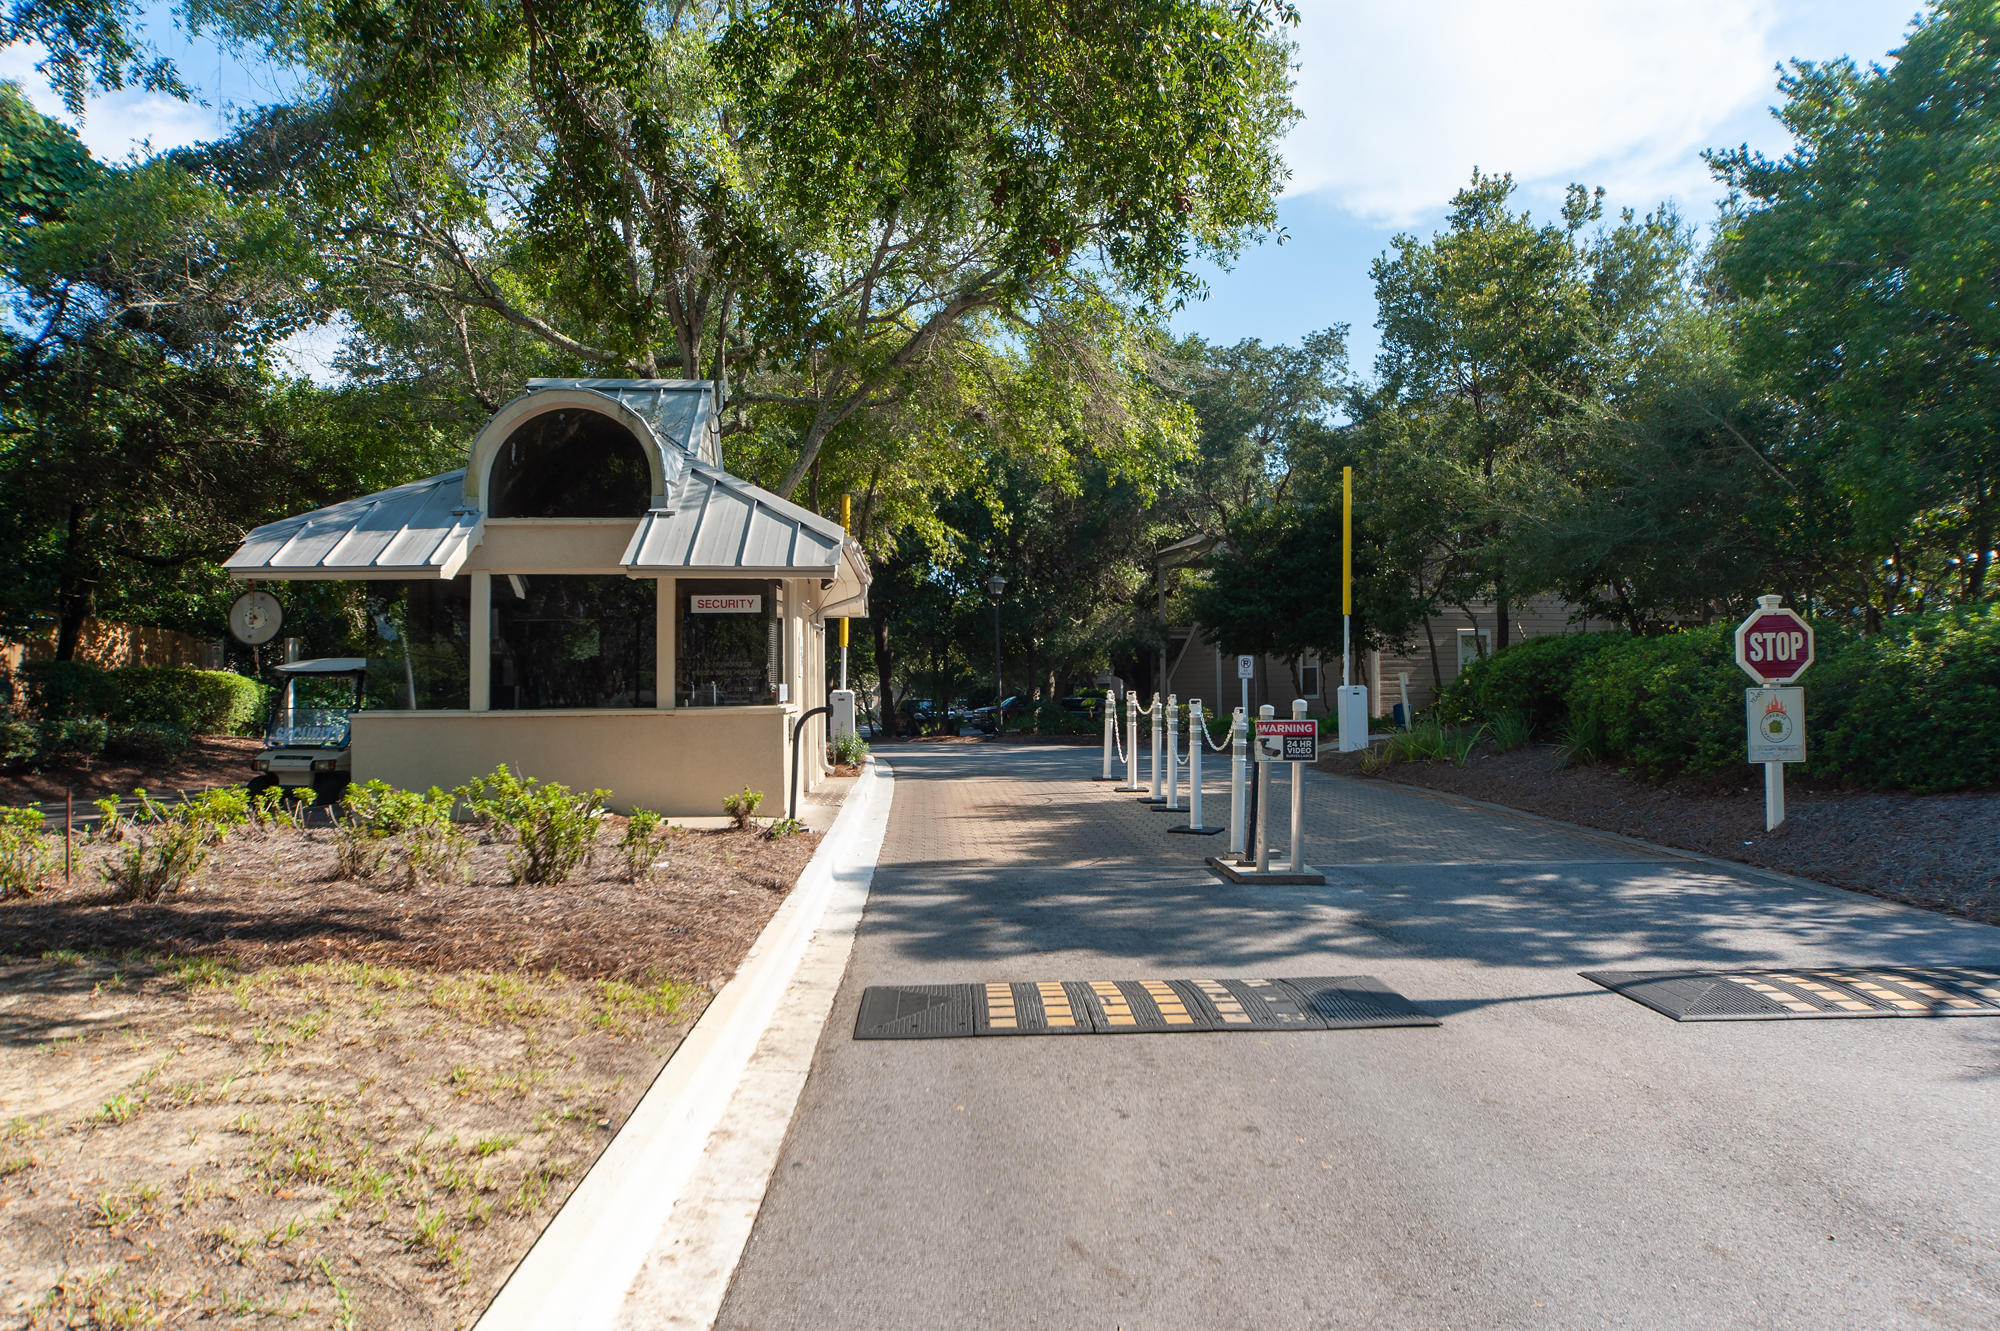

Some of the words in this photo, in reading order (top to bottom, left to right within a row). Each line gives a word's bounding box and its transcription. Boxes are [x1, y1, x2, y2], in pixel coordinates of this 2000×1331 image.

[697, 599, 754, 609] SECURITY
[1749, 632, 1804, 662] STOP
[276, 727, 341, 742] SECURITY
[1259, 724, 1312, 733] WARNING
